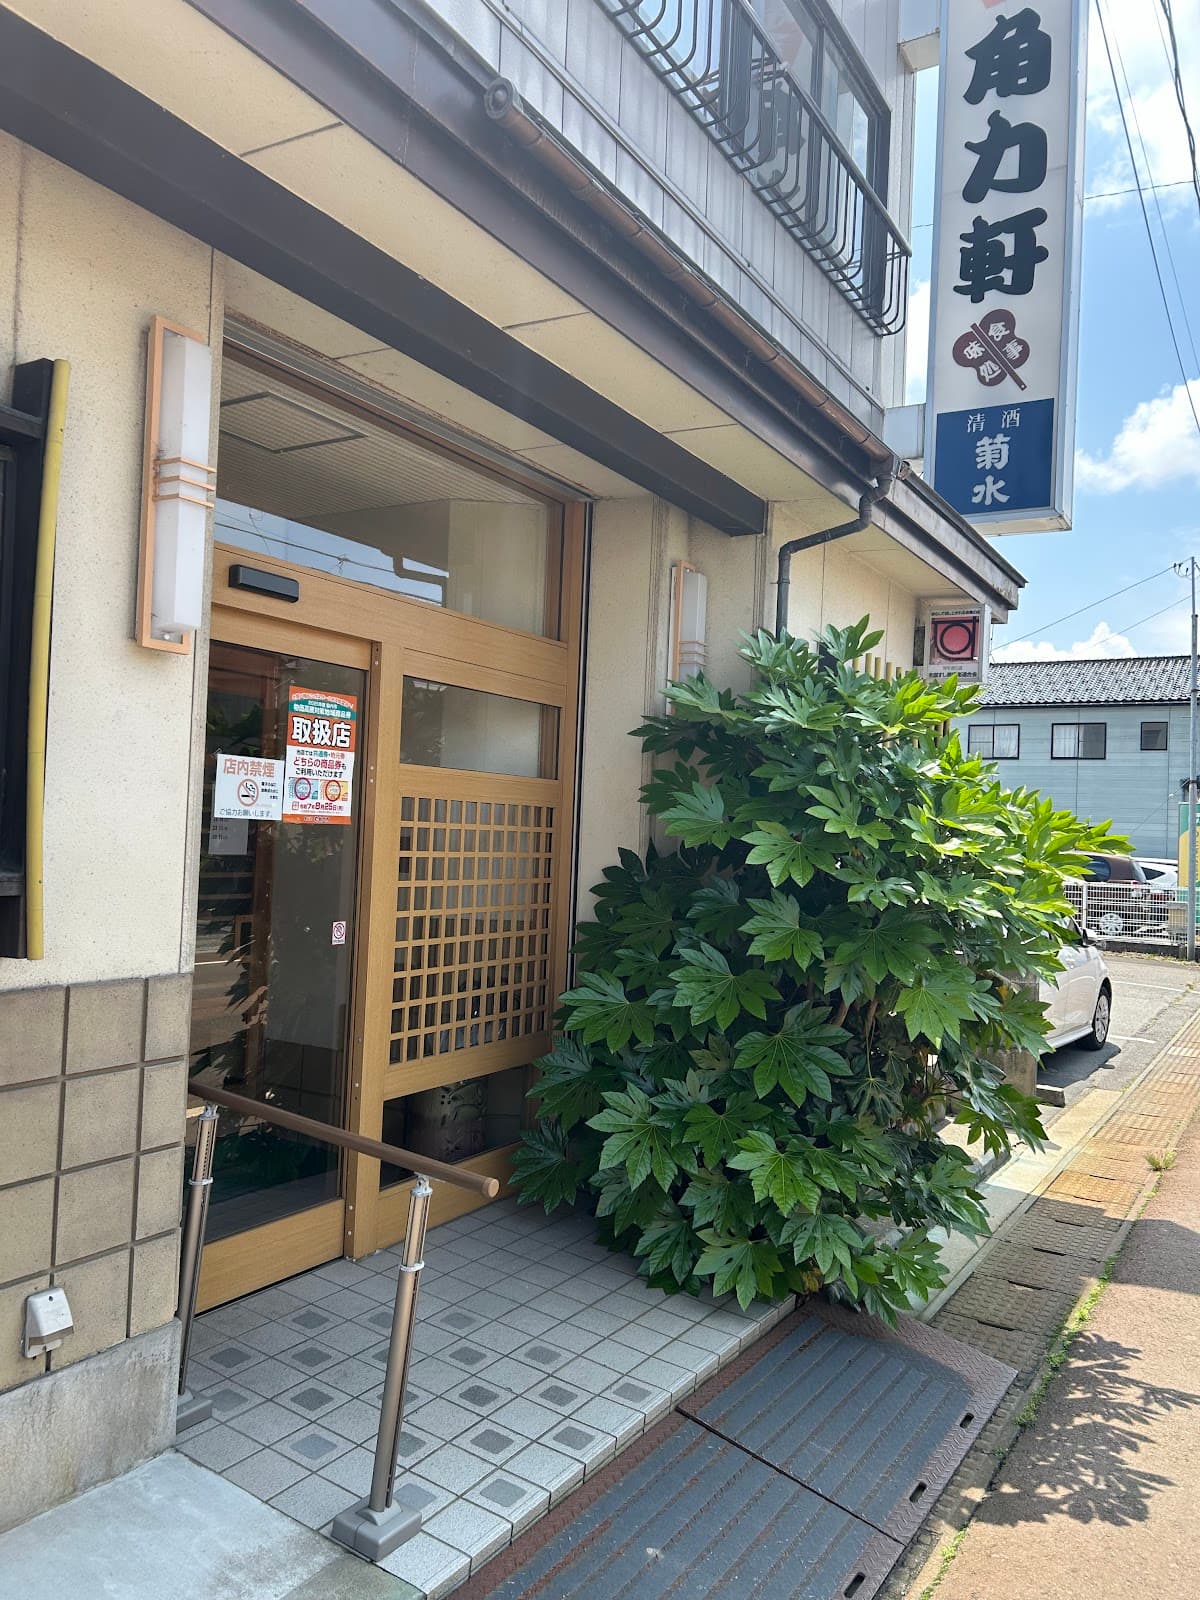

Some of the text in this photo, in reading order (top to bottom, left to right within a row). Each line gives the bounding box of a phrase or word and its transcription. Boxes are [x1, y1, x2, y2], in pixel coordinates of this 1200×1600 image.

[954, 8, 1052, 303] 角力軒
[988, 321, 1024, 360] 食事
[963, 340, 1001, 382] 味処
[971, 433, 1011, 506] 菊水
[292, 717, 351, 748] 取扱店
[223, 757, 275, 778] 店内禁煙
[293, 757, 347, 770] どちらの商品券も
[295, 768, 344, 778] ご利用いただけます
